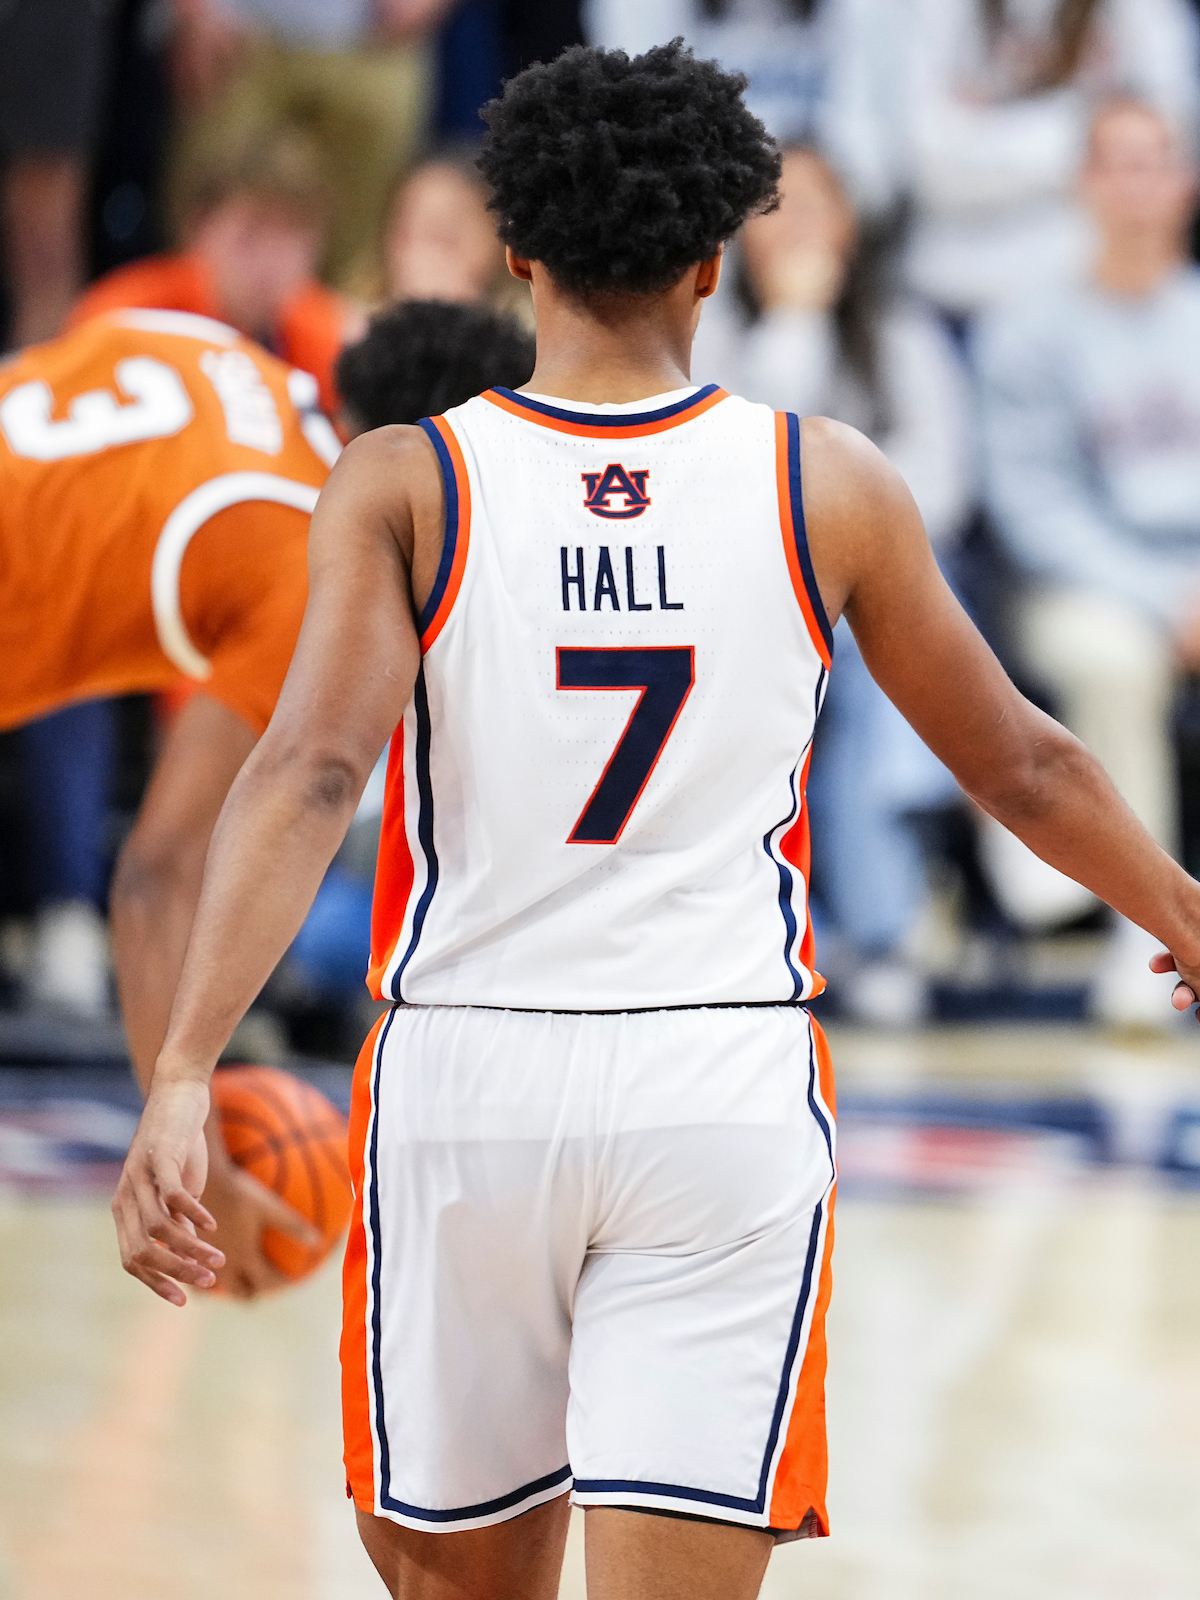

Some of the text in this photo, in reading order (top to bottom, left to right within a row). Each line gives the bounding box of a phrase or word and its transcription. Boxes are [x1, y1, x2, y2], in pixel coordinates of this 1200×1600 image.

[0, 357, 192, 459] 3
[560, 546, 684, 610] HALL
[556, 646, 695, 844] 7
